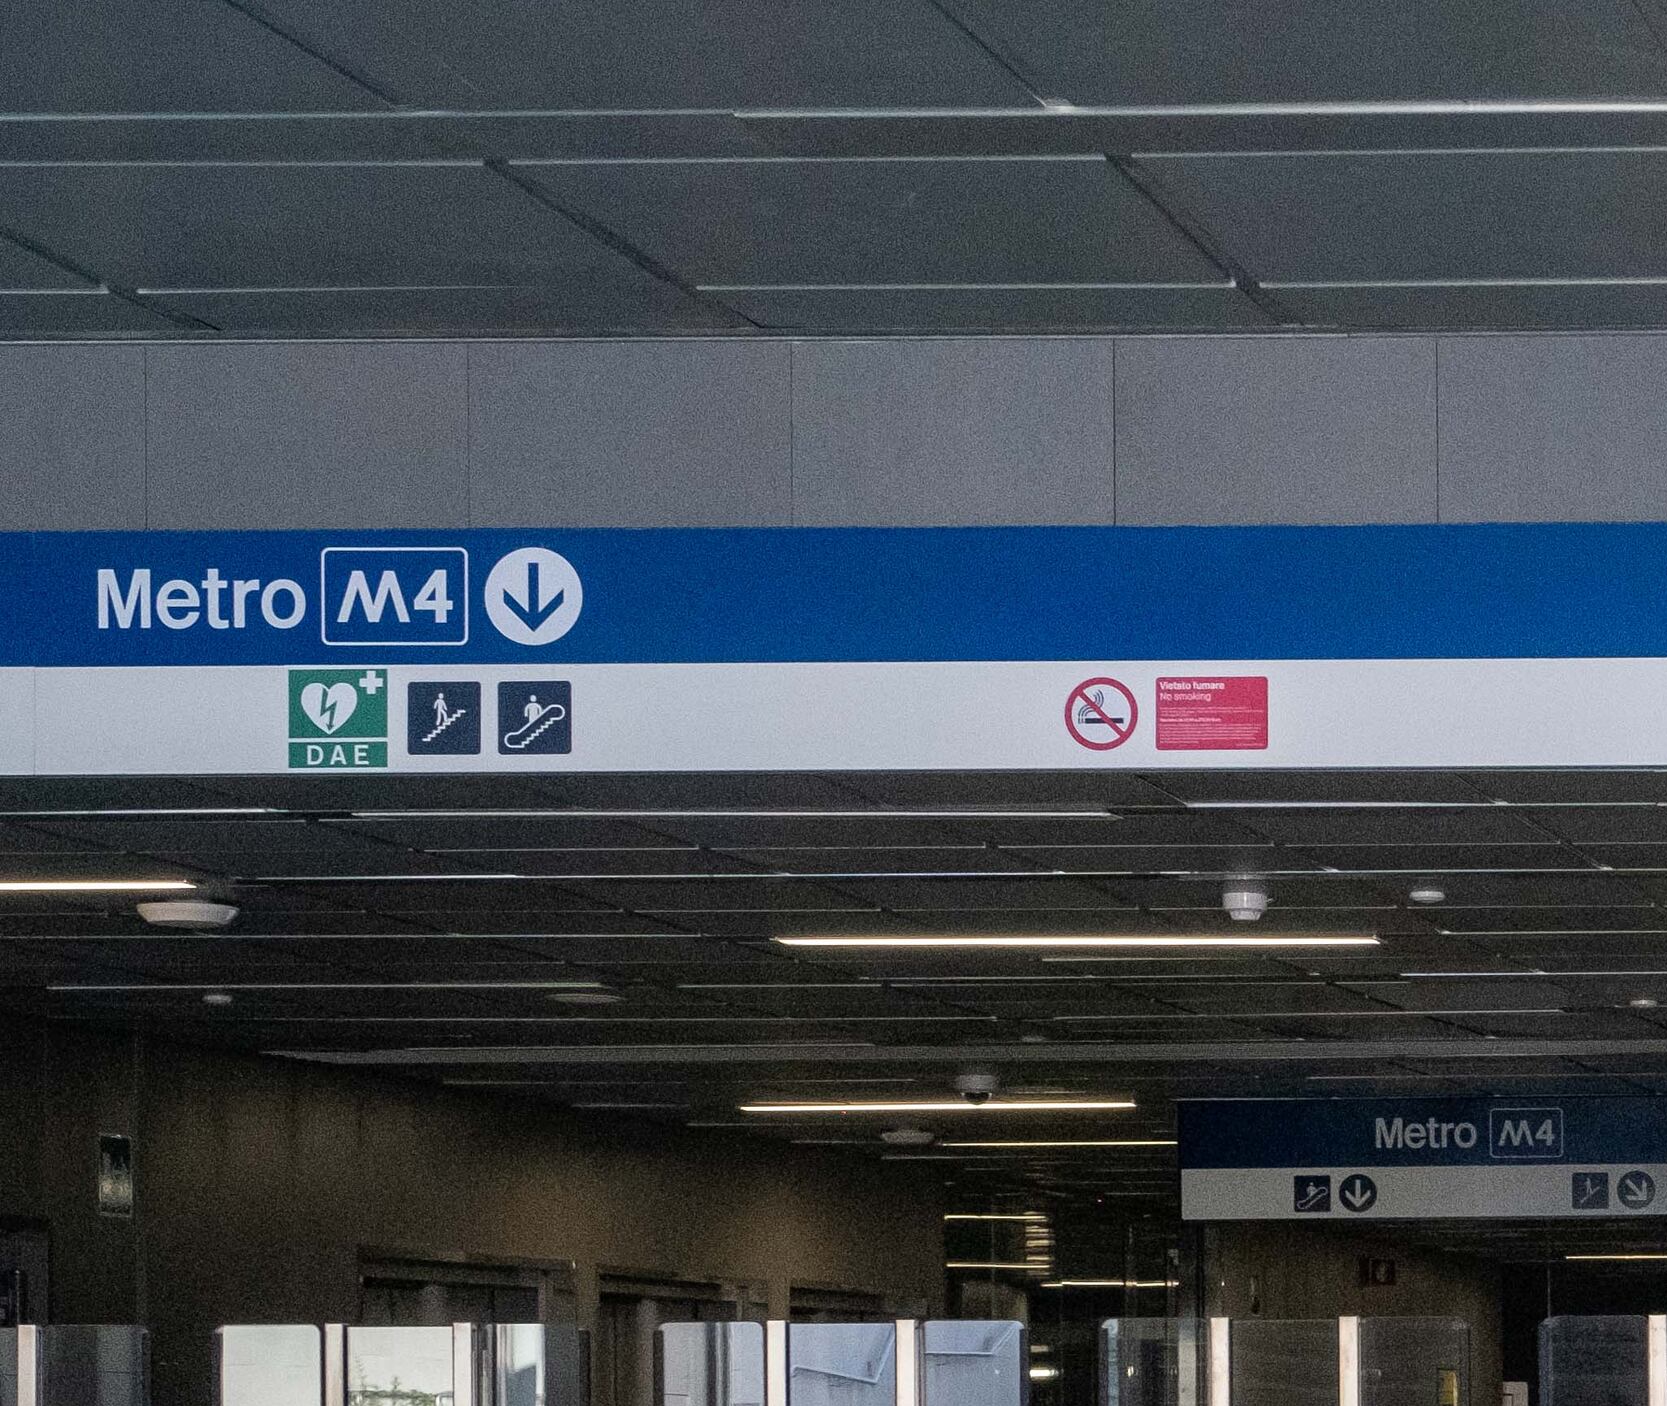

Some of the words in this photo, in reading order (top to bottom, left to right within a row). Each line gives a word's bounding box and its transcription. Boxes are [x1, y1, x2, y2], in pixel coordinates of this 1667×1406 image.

[97, 568, 307, 630] Metro
[337, 569, 454, 624] M4
[1160, 681, 1191, 690] Vietato
[1193, 681, 1225, 690] fumare
[1160, 692, 1173, 701] No
[1174, 692, 1211, 703] smoking
[306, 744, 370, 766] DAE
[1374, 1117, 1478, 1149] Metro
[1498, 1118, 1556, 1147] M4
